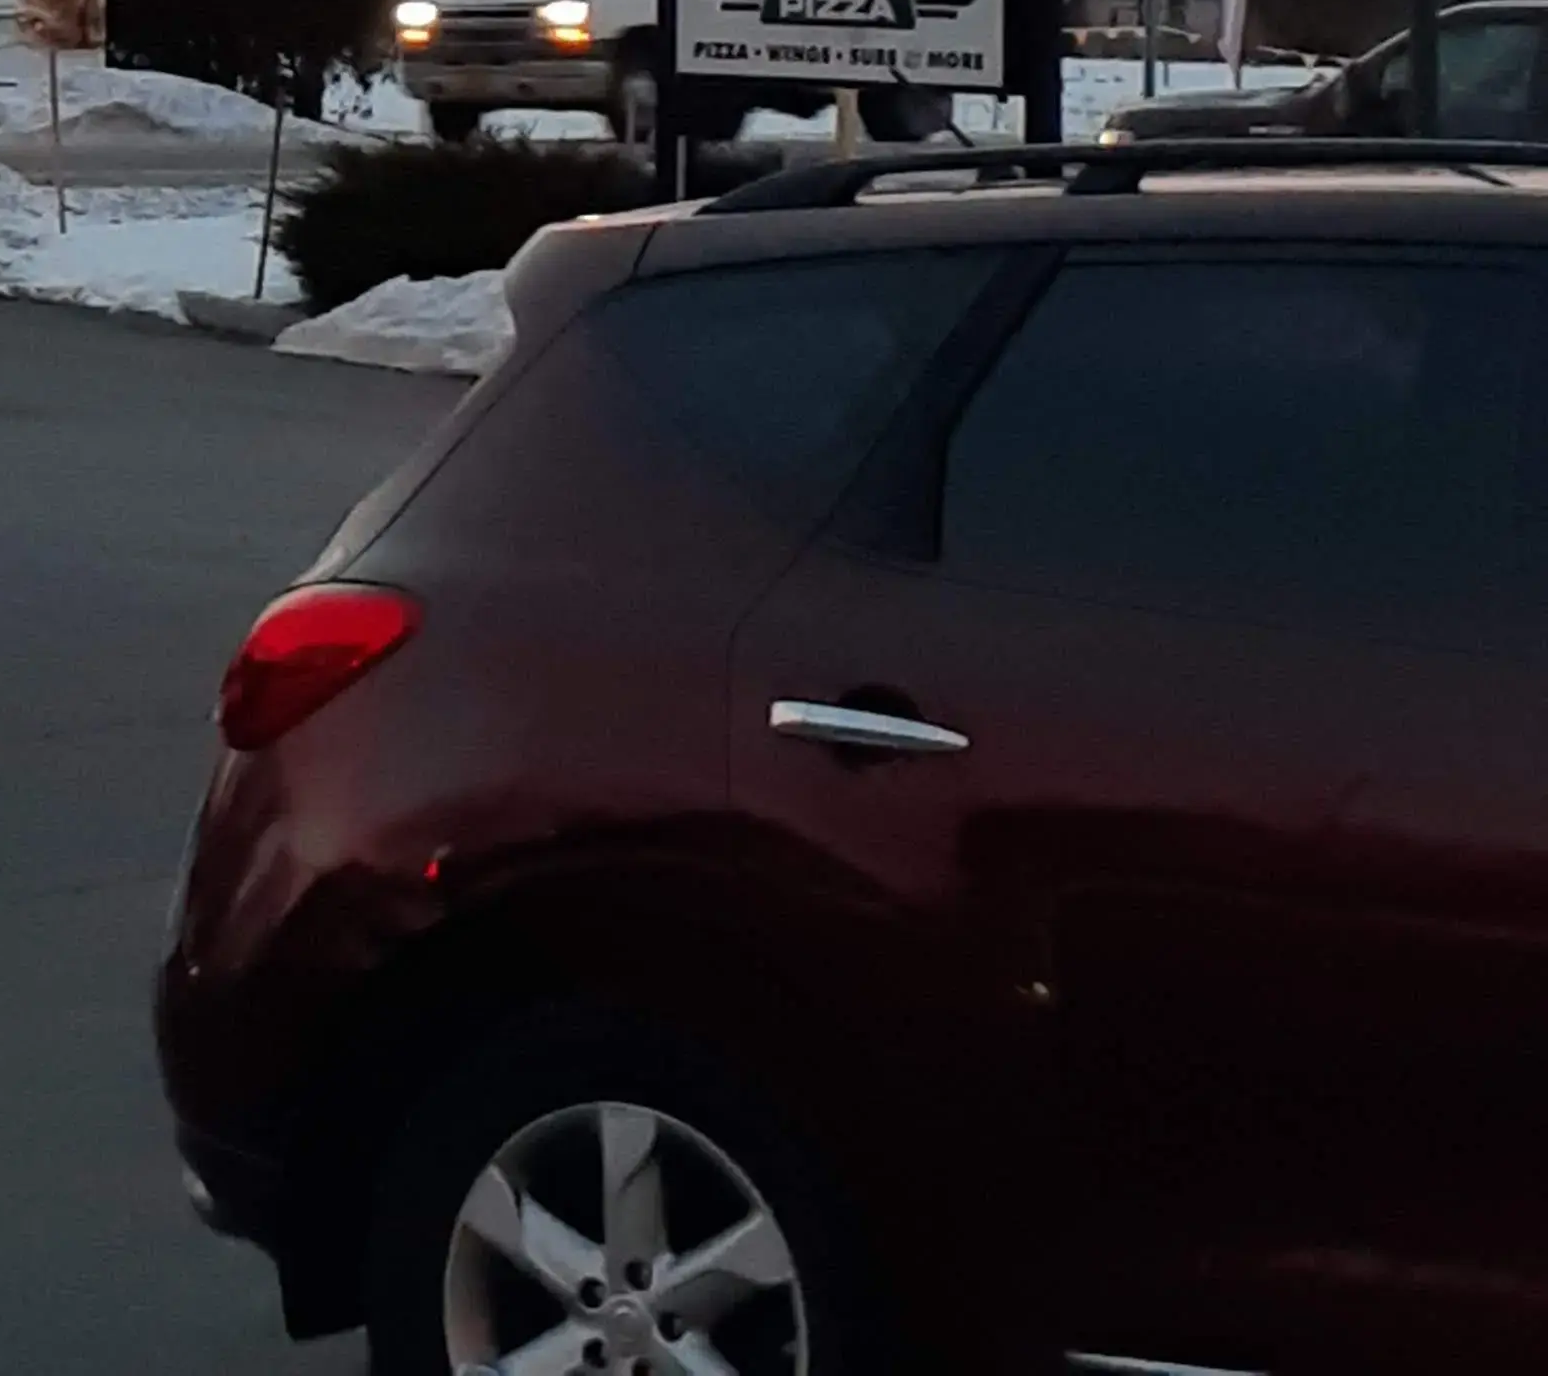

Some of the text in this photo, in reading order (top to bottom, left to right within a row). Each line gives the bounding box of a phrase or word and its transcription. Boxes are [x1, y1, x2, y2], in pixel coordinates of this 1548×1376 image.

[693, 41, 749, 60] PIZZA
[766, 43, 831, 65] WINGS
[849, 47, 898, 67] SUBS
[926, 51, 985, 71] MORE
